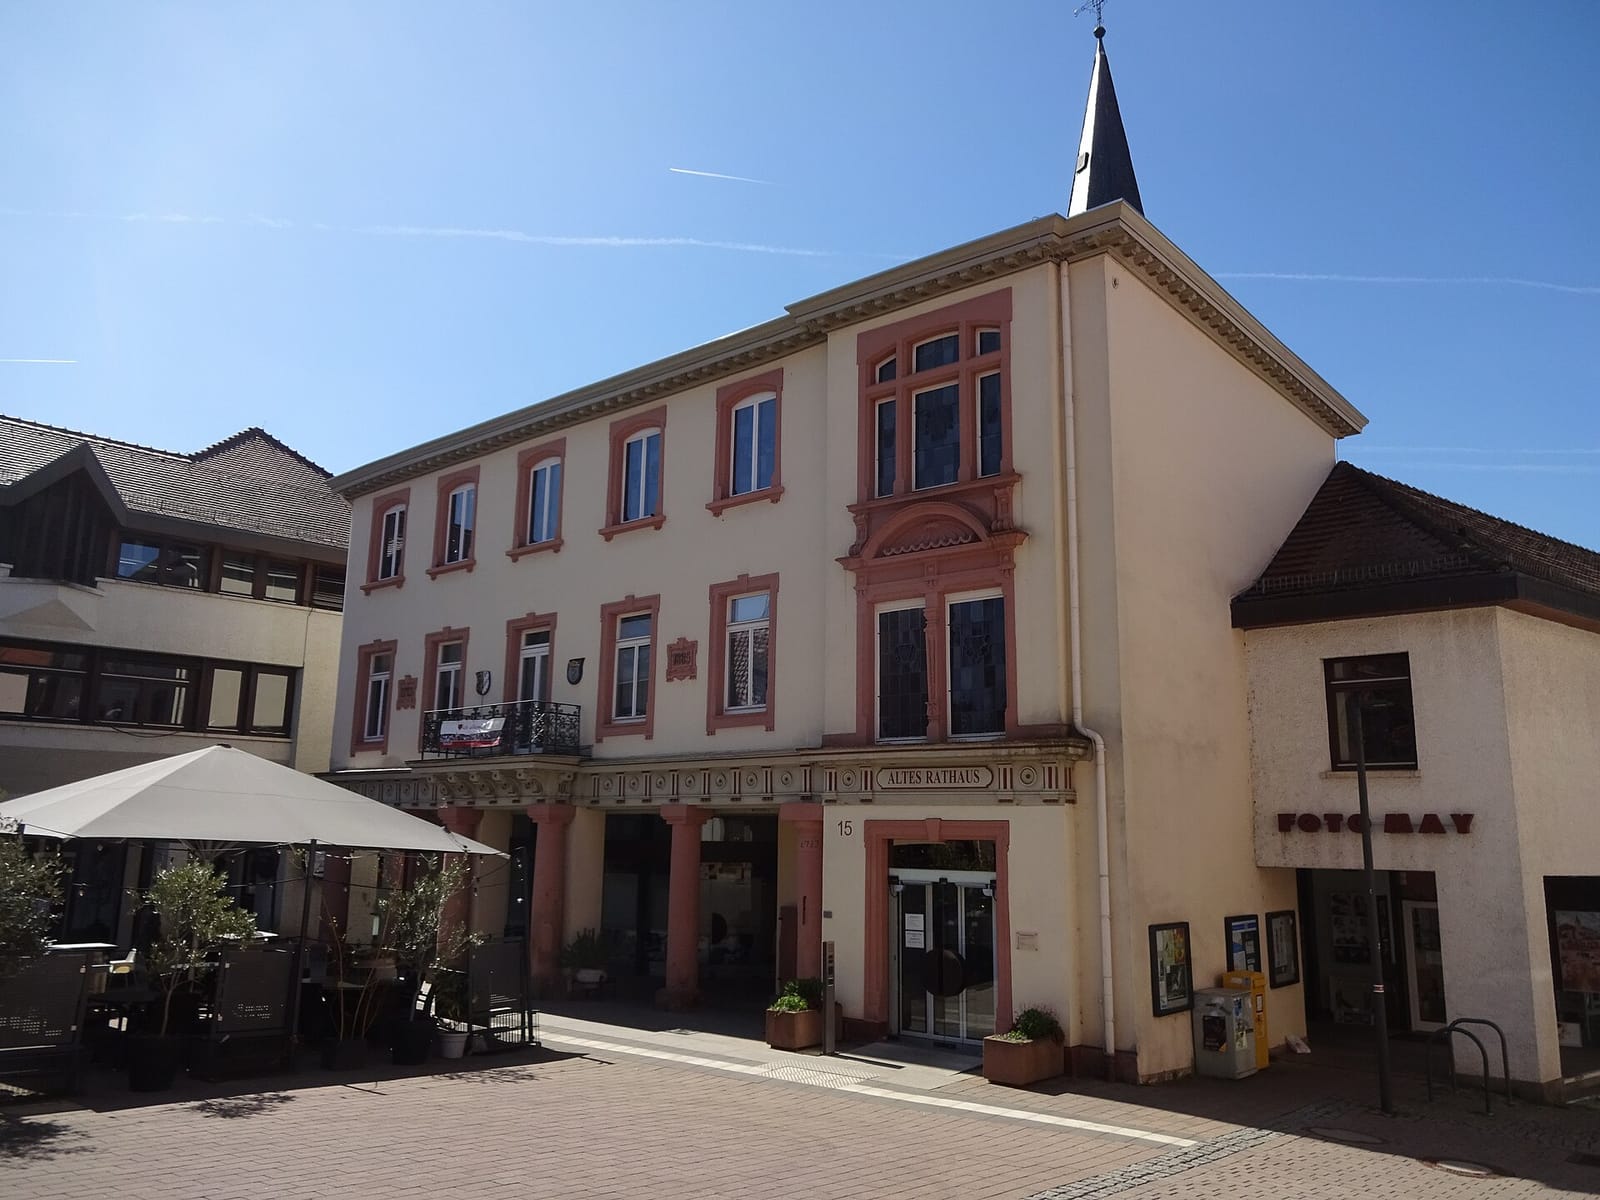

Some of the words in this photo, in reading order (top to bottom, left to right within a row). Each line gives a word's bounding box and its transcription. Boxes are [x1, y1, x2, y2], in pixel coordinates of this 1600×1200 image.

[888, 770, 922, 785] ALTES
[926, 769, 980, 784] RATHAUS
[838, 820, 853, 837] 15
[1277, 813, 1372, 834] FOTO
[1384, 813, 1475, 834] MAY
